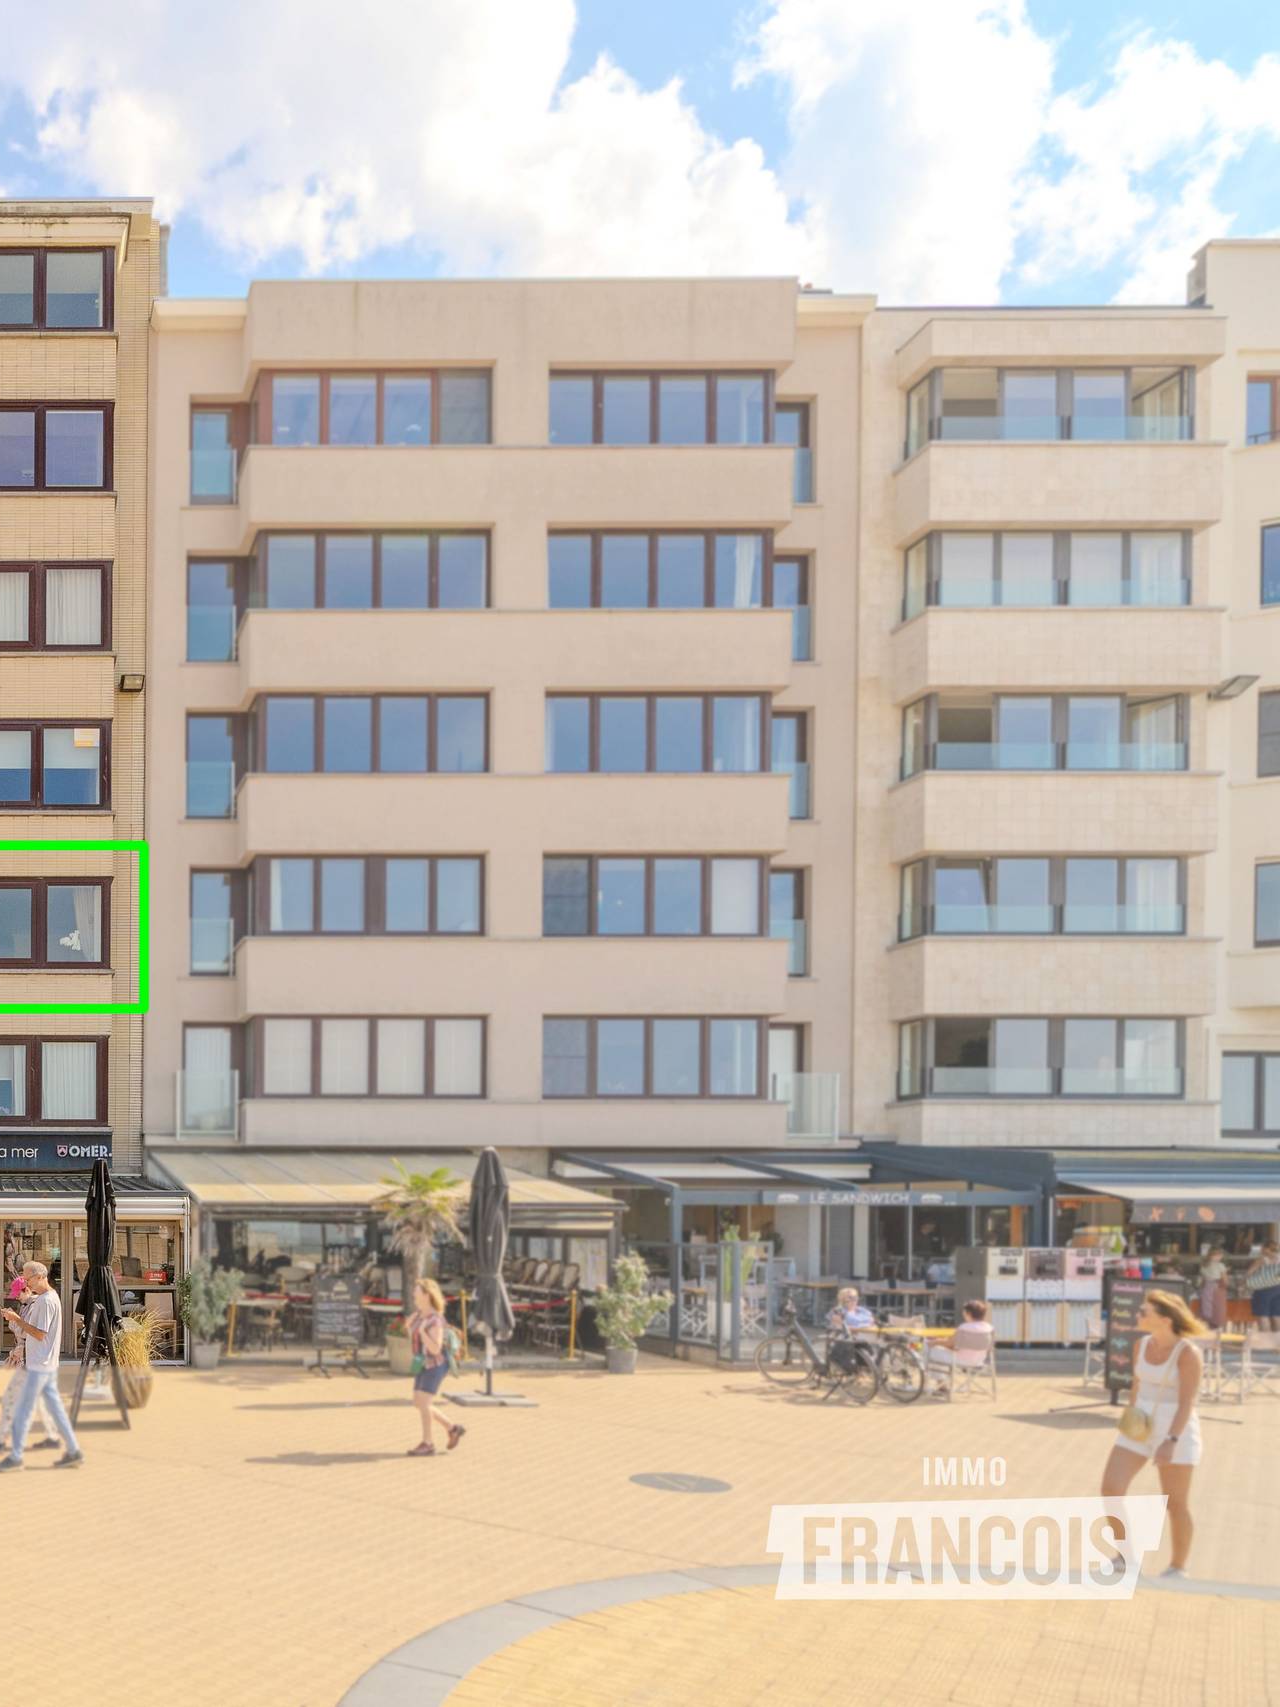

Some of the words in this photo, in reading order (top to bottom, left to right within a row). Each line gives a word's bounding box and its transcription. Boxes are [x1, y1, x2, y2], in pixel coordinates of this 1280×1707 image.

[11, 1147, 39, 1158] mer
[810, 1191, 826, 1205] LE
[831, 1191, 910, 1205] SANDWICH
